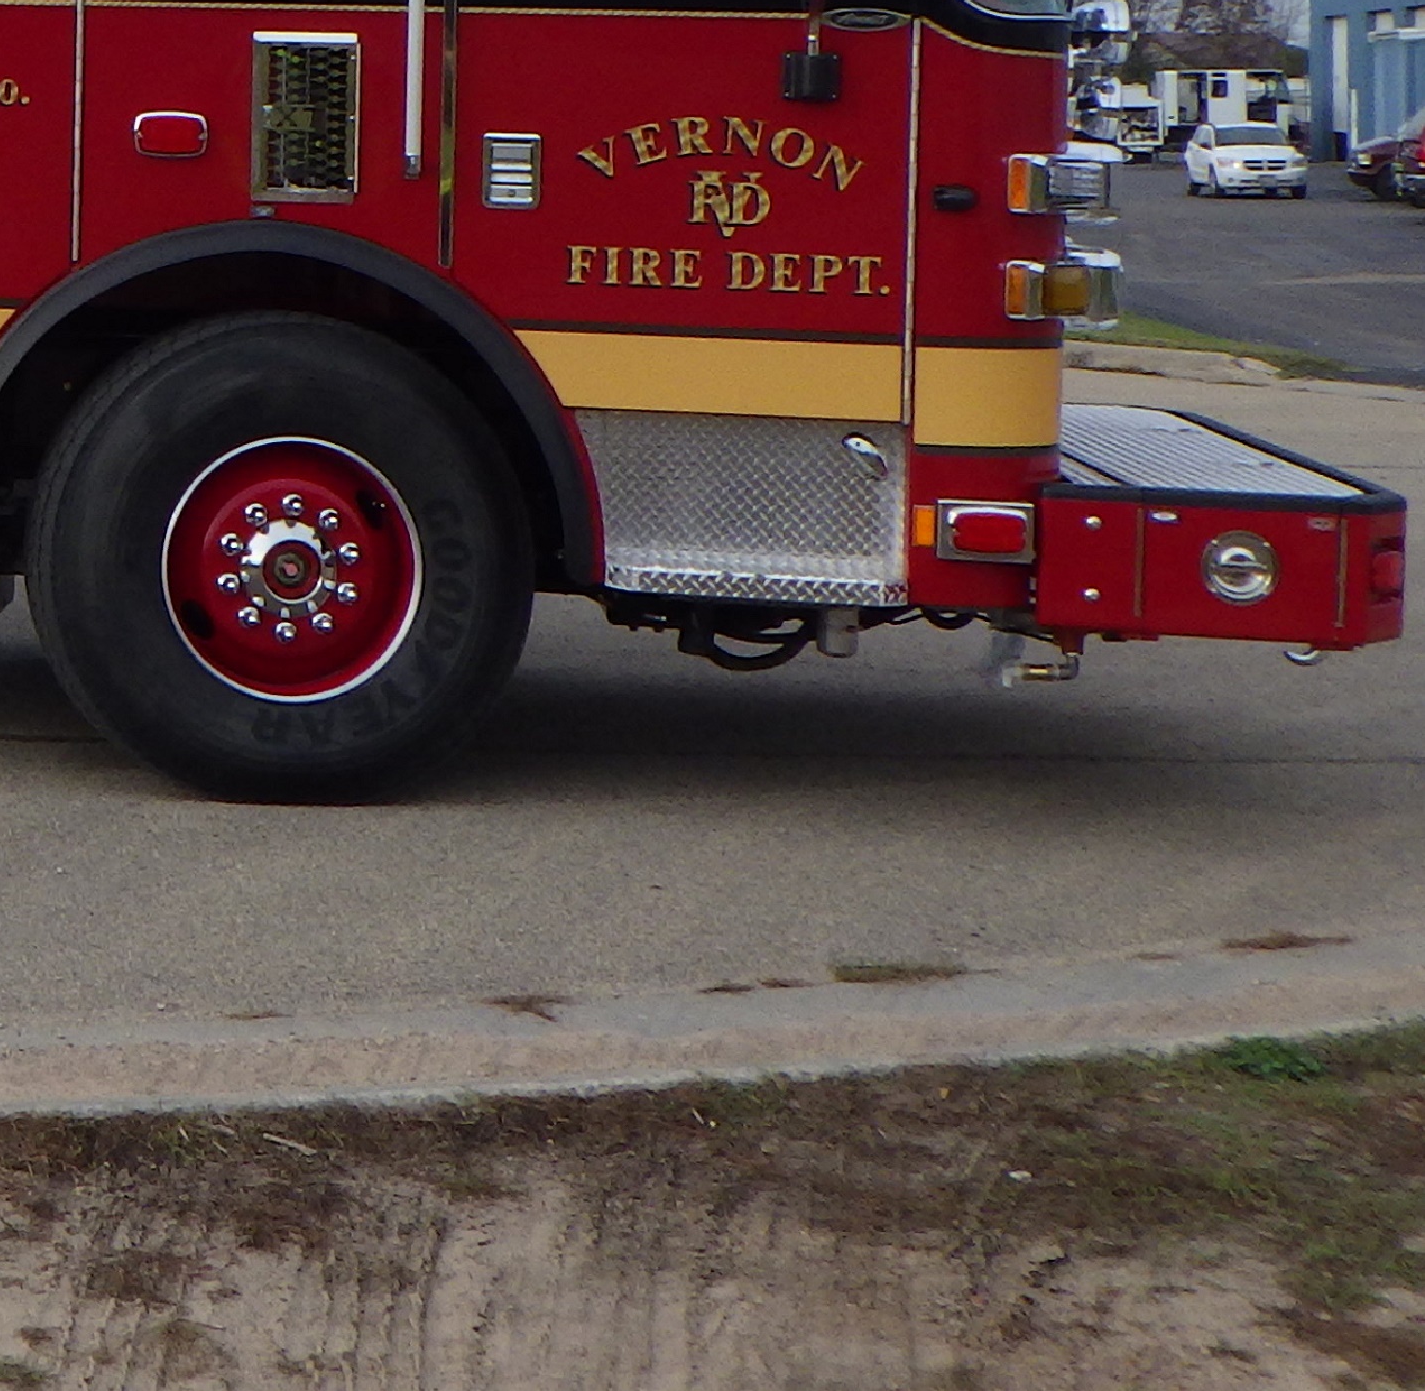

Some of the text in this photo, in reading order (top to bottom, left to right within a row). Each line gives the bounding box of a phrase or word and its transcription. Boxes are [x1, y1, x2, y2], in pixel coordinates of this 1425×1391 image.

[576, 116, 866, 192] VERNON
[566, 245, 891, 295] FIRE DEPT.
[248, 497, 472, 744] GOODYEAR
